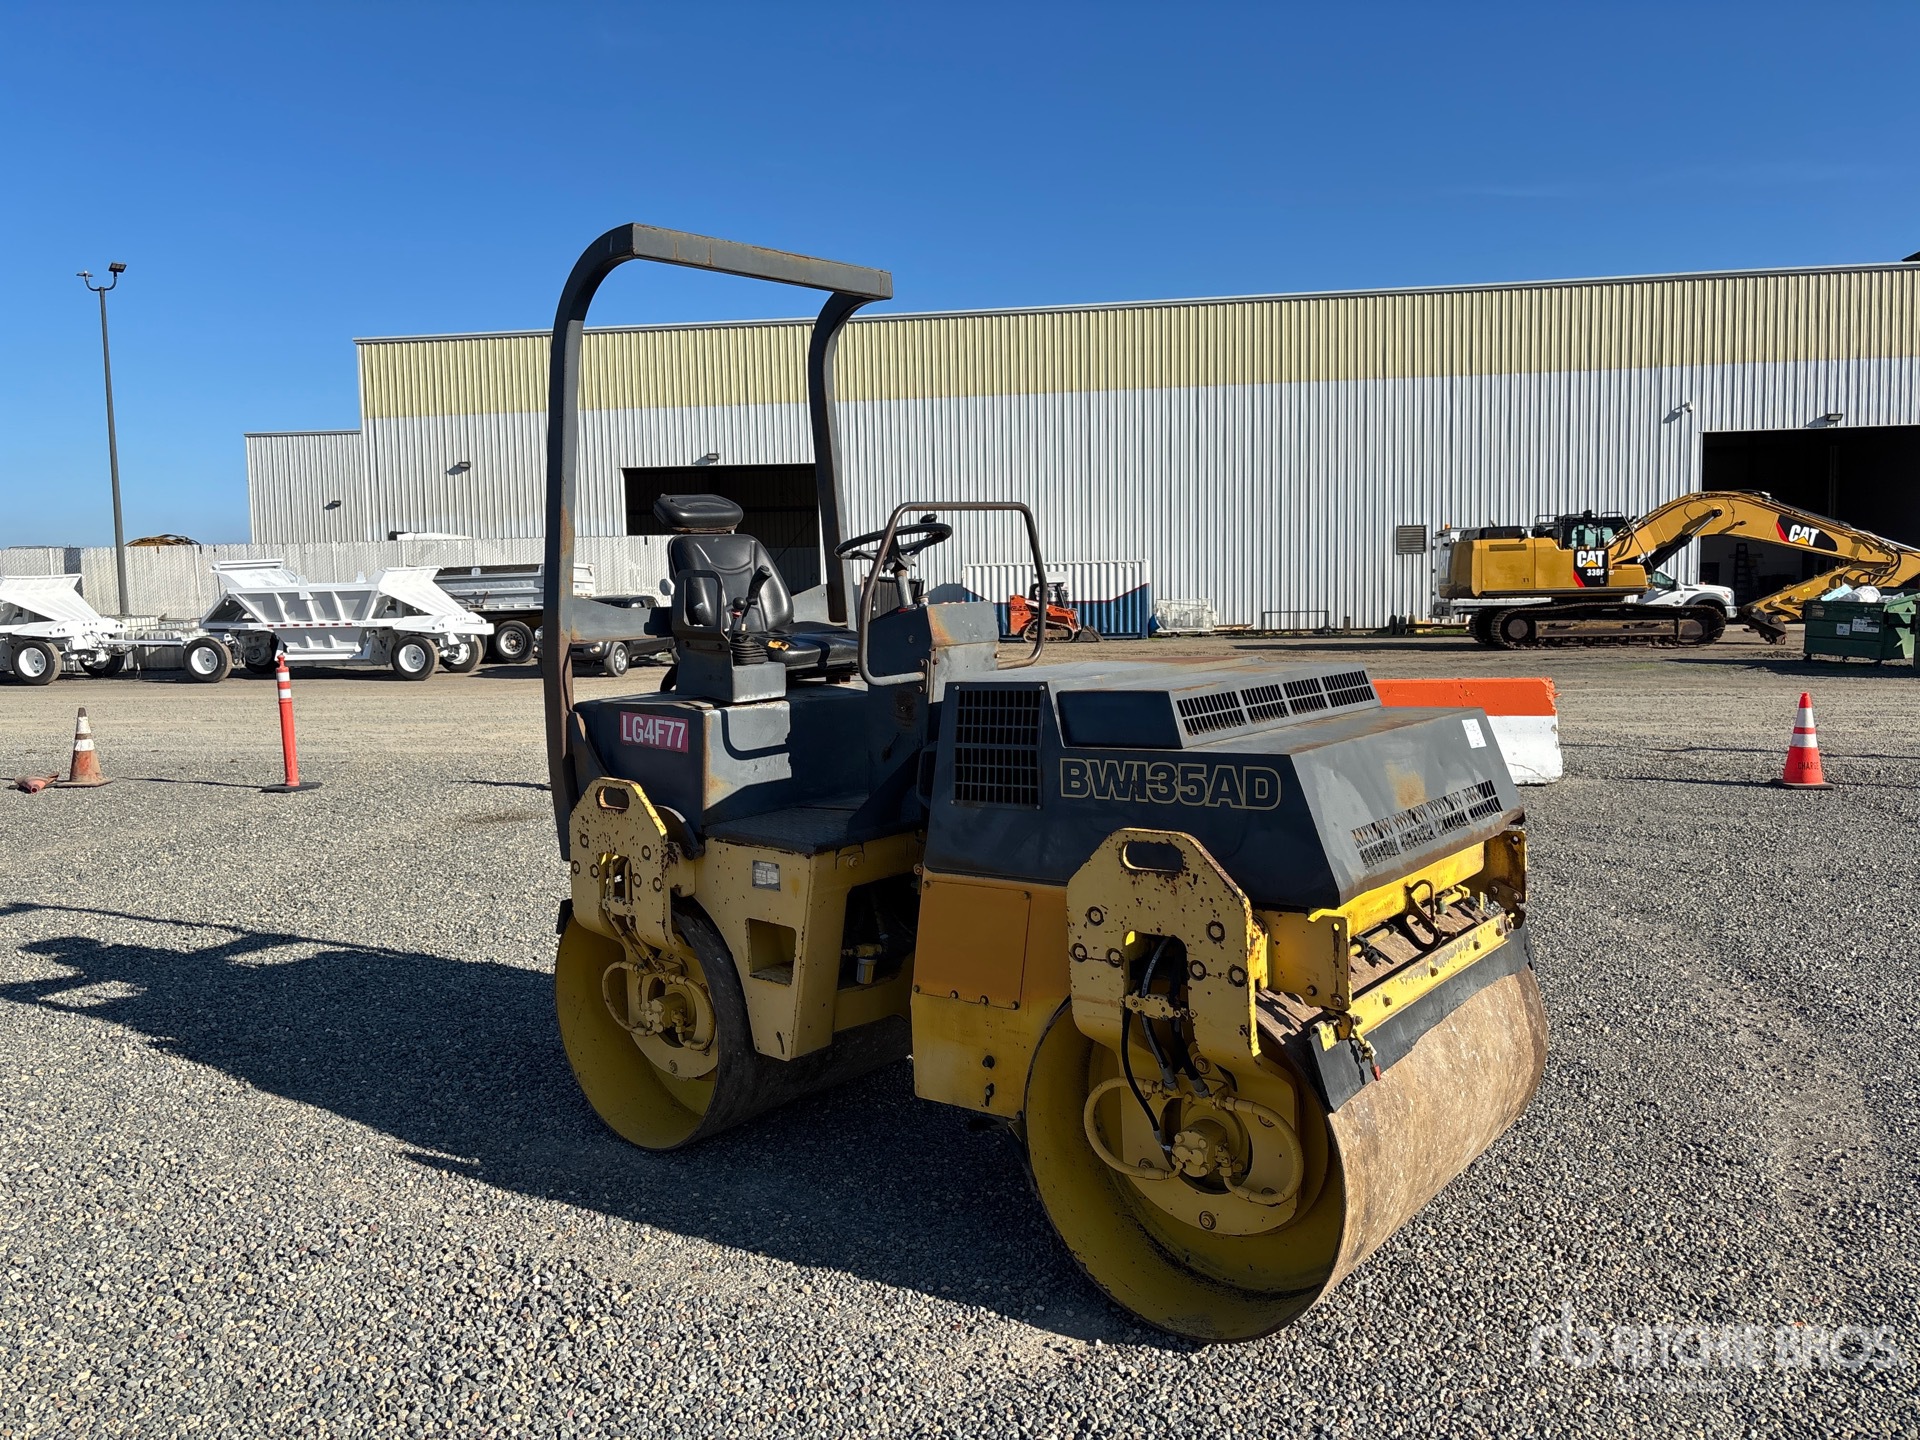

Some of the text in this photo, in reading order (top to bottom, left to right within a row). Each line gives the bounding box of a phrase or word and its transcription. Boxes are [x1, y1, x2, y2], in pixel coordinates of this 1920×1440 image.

[1788, 524, 1820, 547] CAT
[1576, 550, 1605, 568] CAT
[622, 715, 686, 749] LG4F77
[1059, 758, 1282, 811] BW135AD
